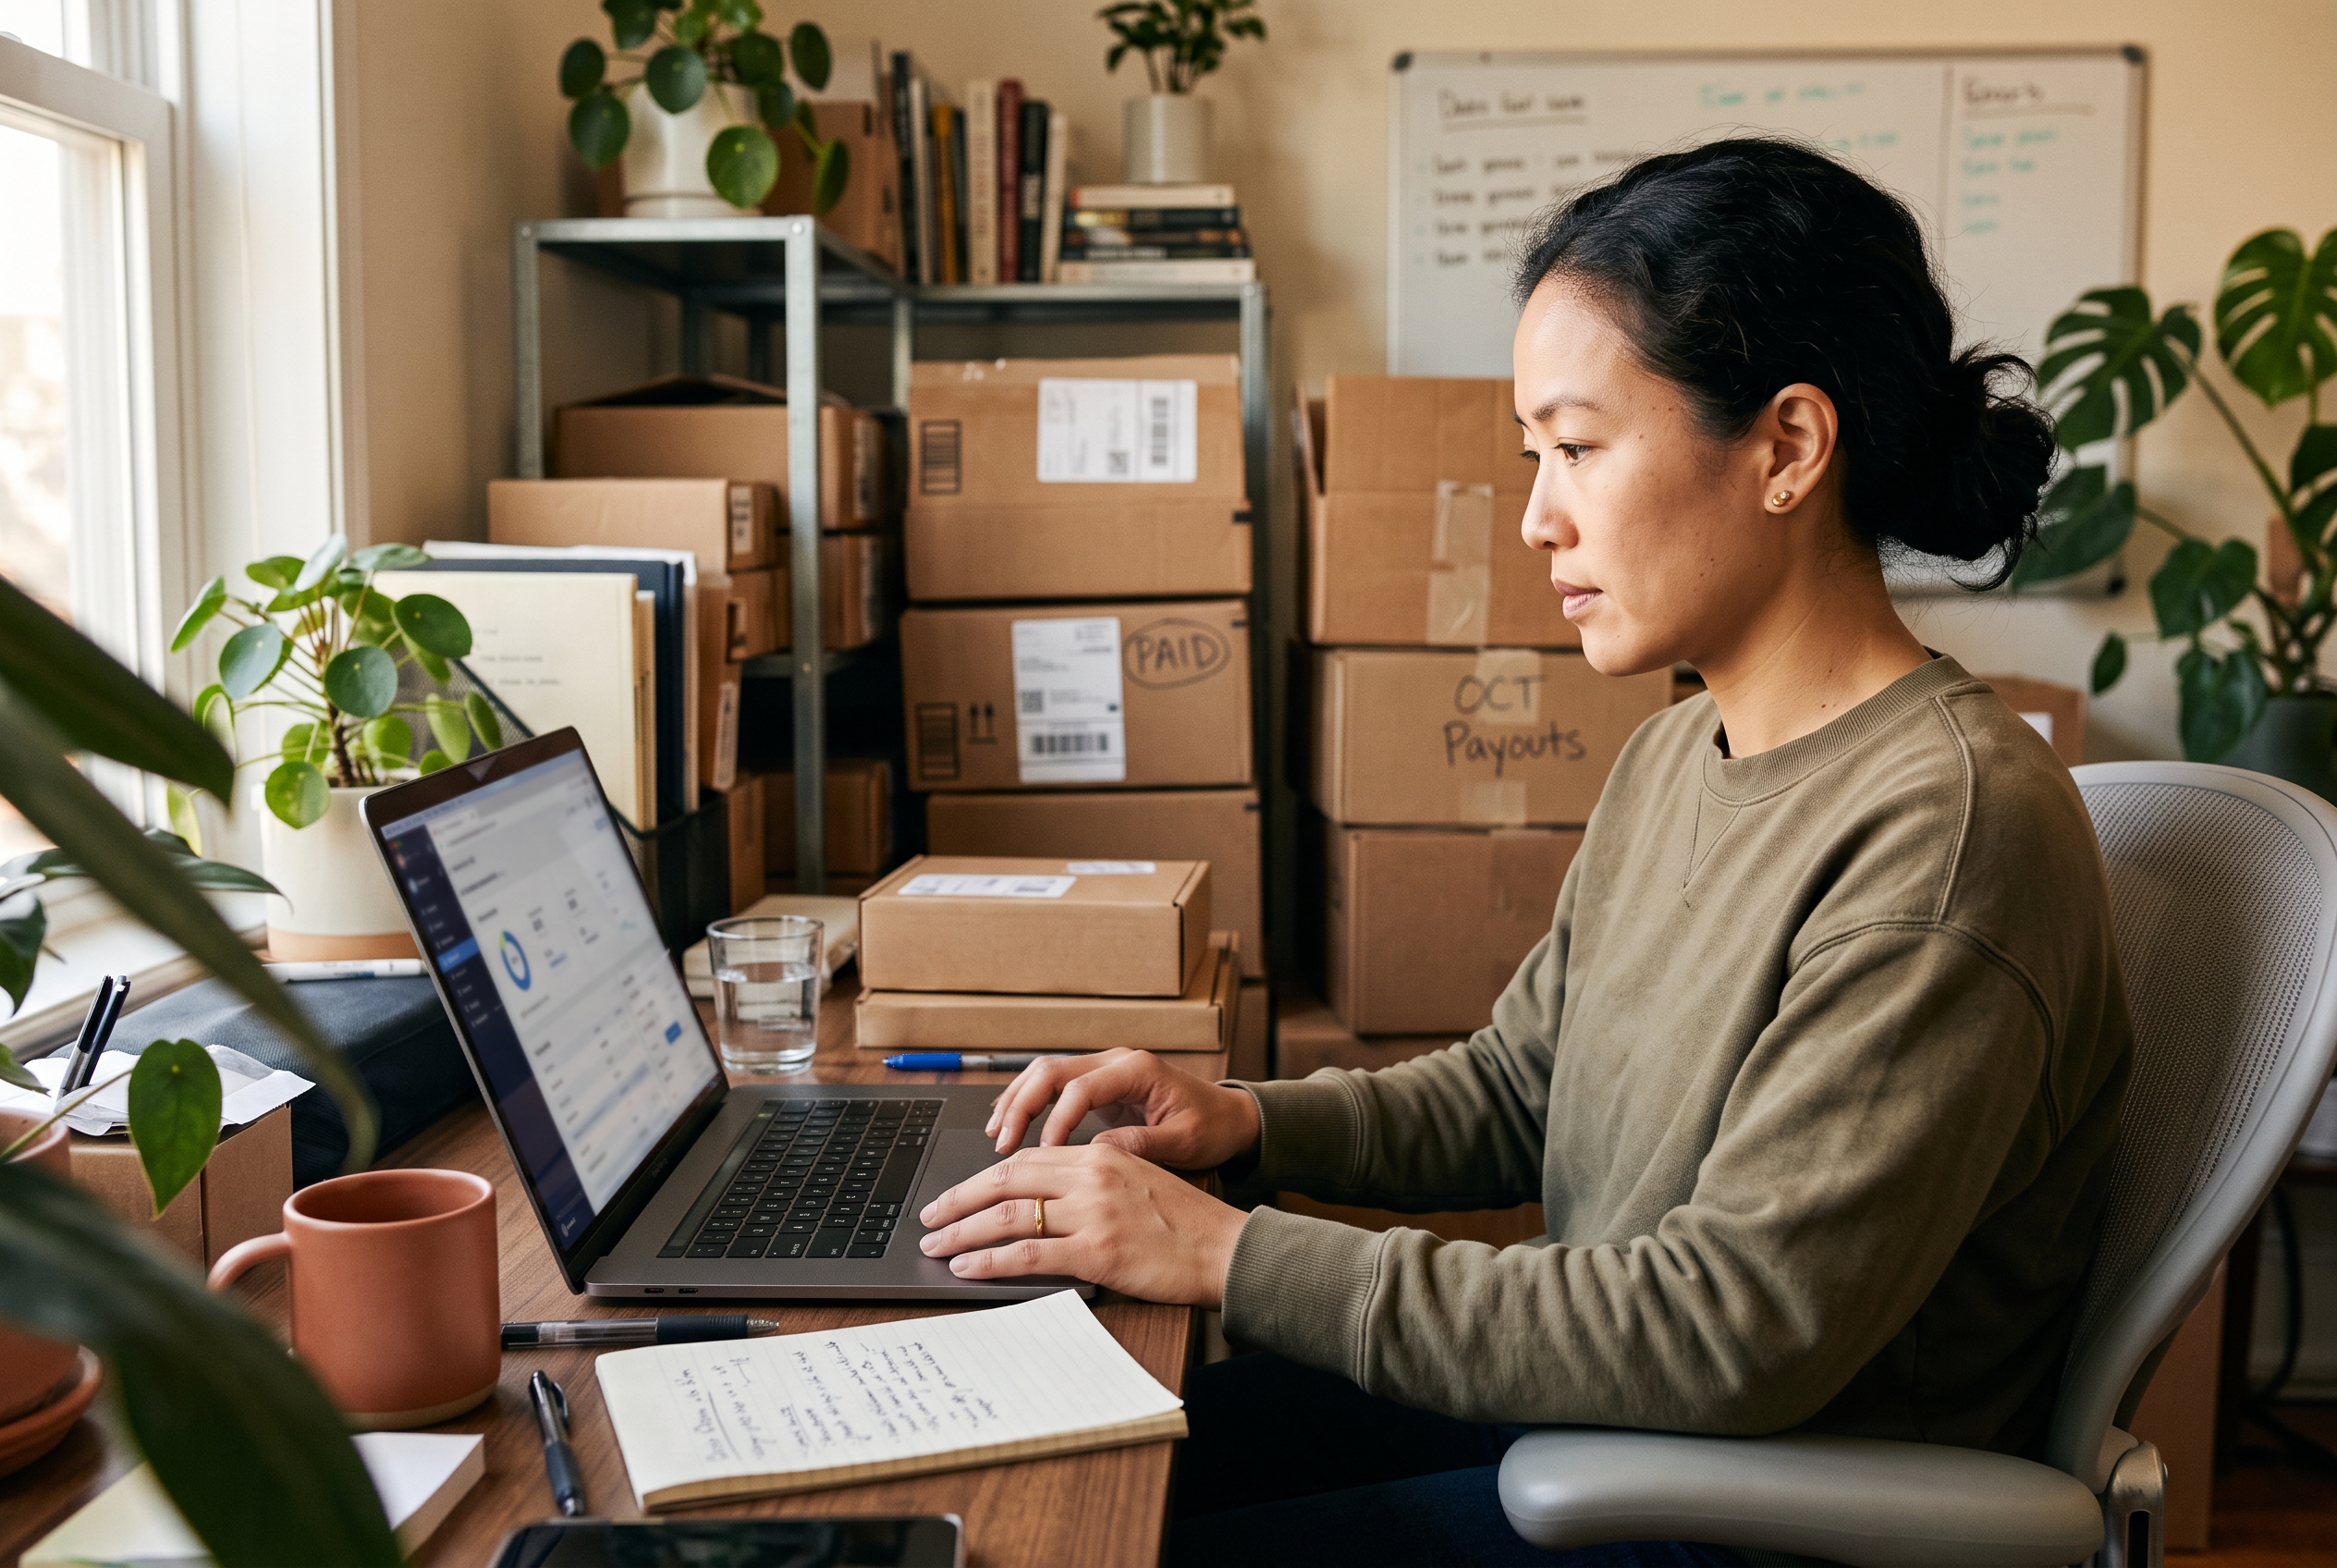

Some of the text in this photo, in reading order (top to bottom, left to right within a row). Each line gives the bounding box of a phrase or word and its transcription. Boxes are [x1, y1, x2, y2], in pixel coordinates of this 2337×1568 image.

[1134, 632, 1220, 675] PAID
[1454, 674, 1548, 715] OCT
[1442, 719, 1587, 778] Payouts
